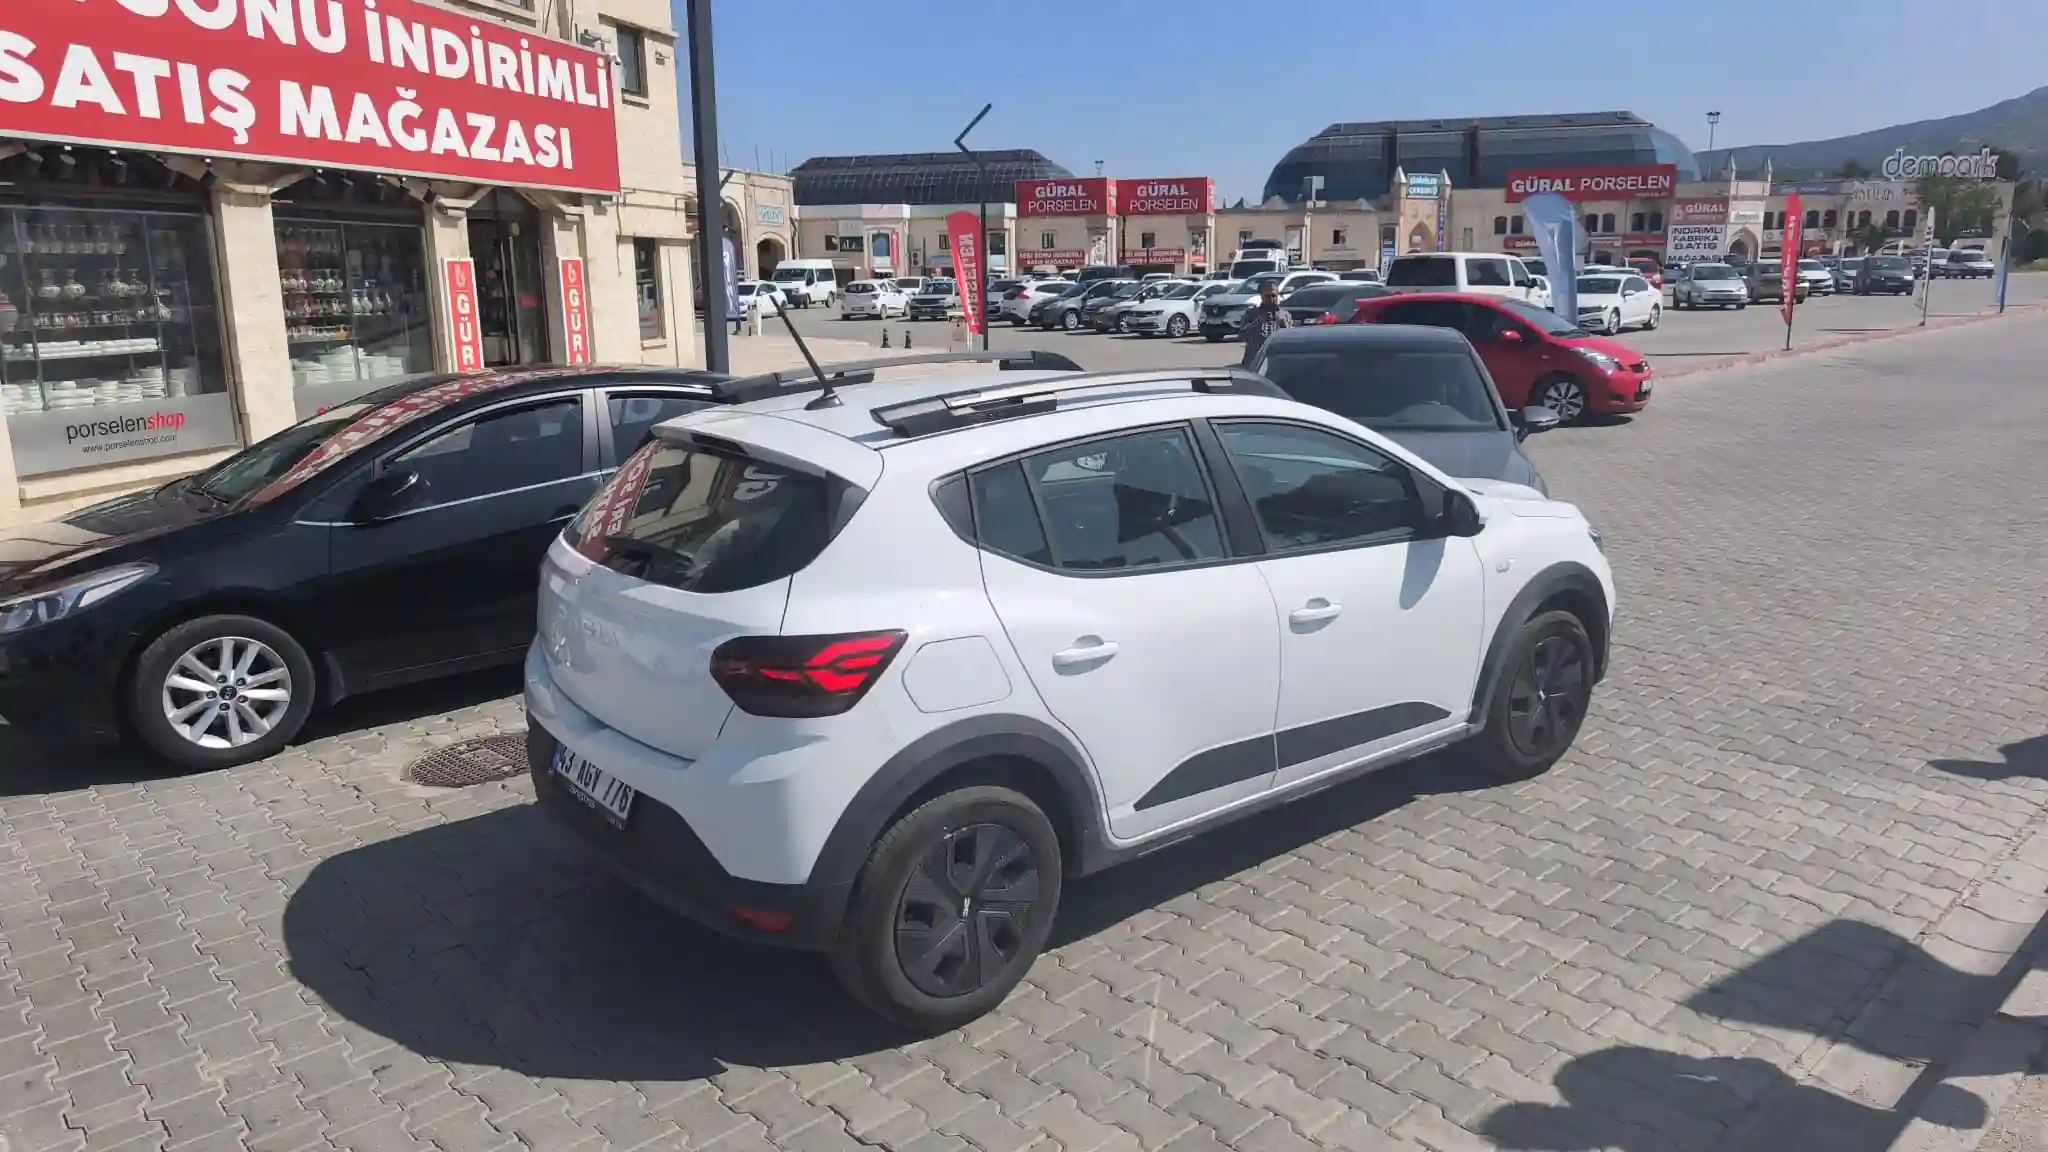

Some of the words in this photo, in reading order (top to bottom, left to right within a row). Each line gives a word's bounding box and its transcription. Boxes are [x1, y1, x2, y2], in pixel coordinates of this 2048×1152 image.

[363, 0, 609, 109] İNDİRİMLİ
[0, 30, 256, 145] SATIŞ
[279, 79, 573, 169] MAĞAZASI
[1035, 182, 1088, 198] GÜRAL
[1136, 181, 1189, 197] GÜRAL
[1511, 175, 1575, 194] GÜRAL
[1580, 174, 1671, 191] PORSELEN
[1028, 198, 1098, 213] PORSELEN
[1129, 197, 1199, 212] PORSELEN
[1685, 202, 1726, 213] GÜRAL
[457, 294, 475, 371] GÜR
[66, 411, 185, 444] porselenshop
[560, 745, 576, 774] 43
[577, 760, 602, 793] AGV
